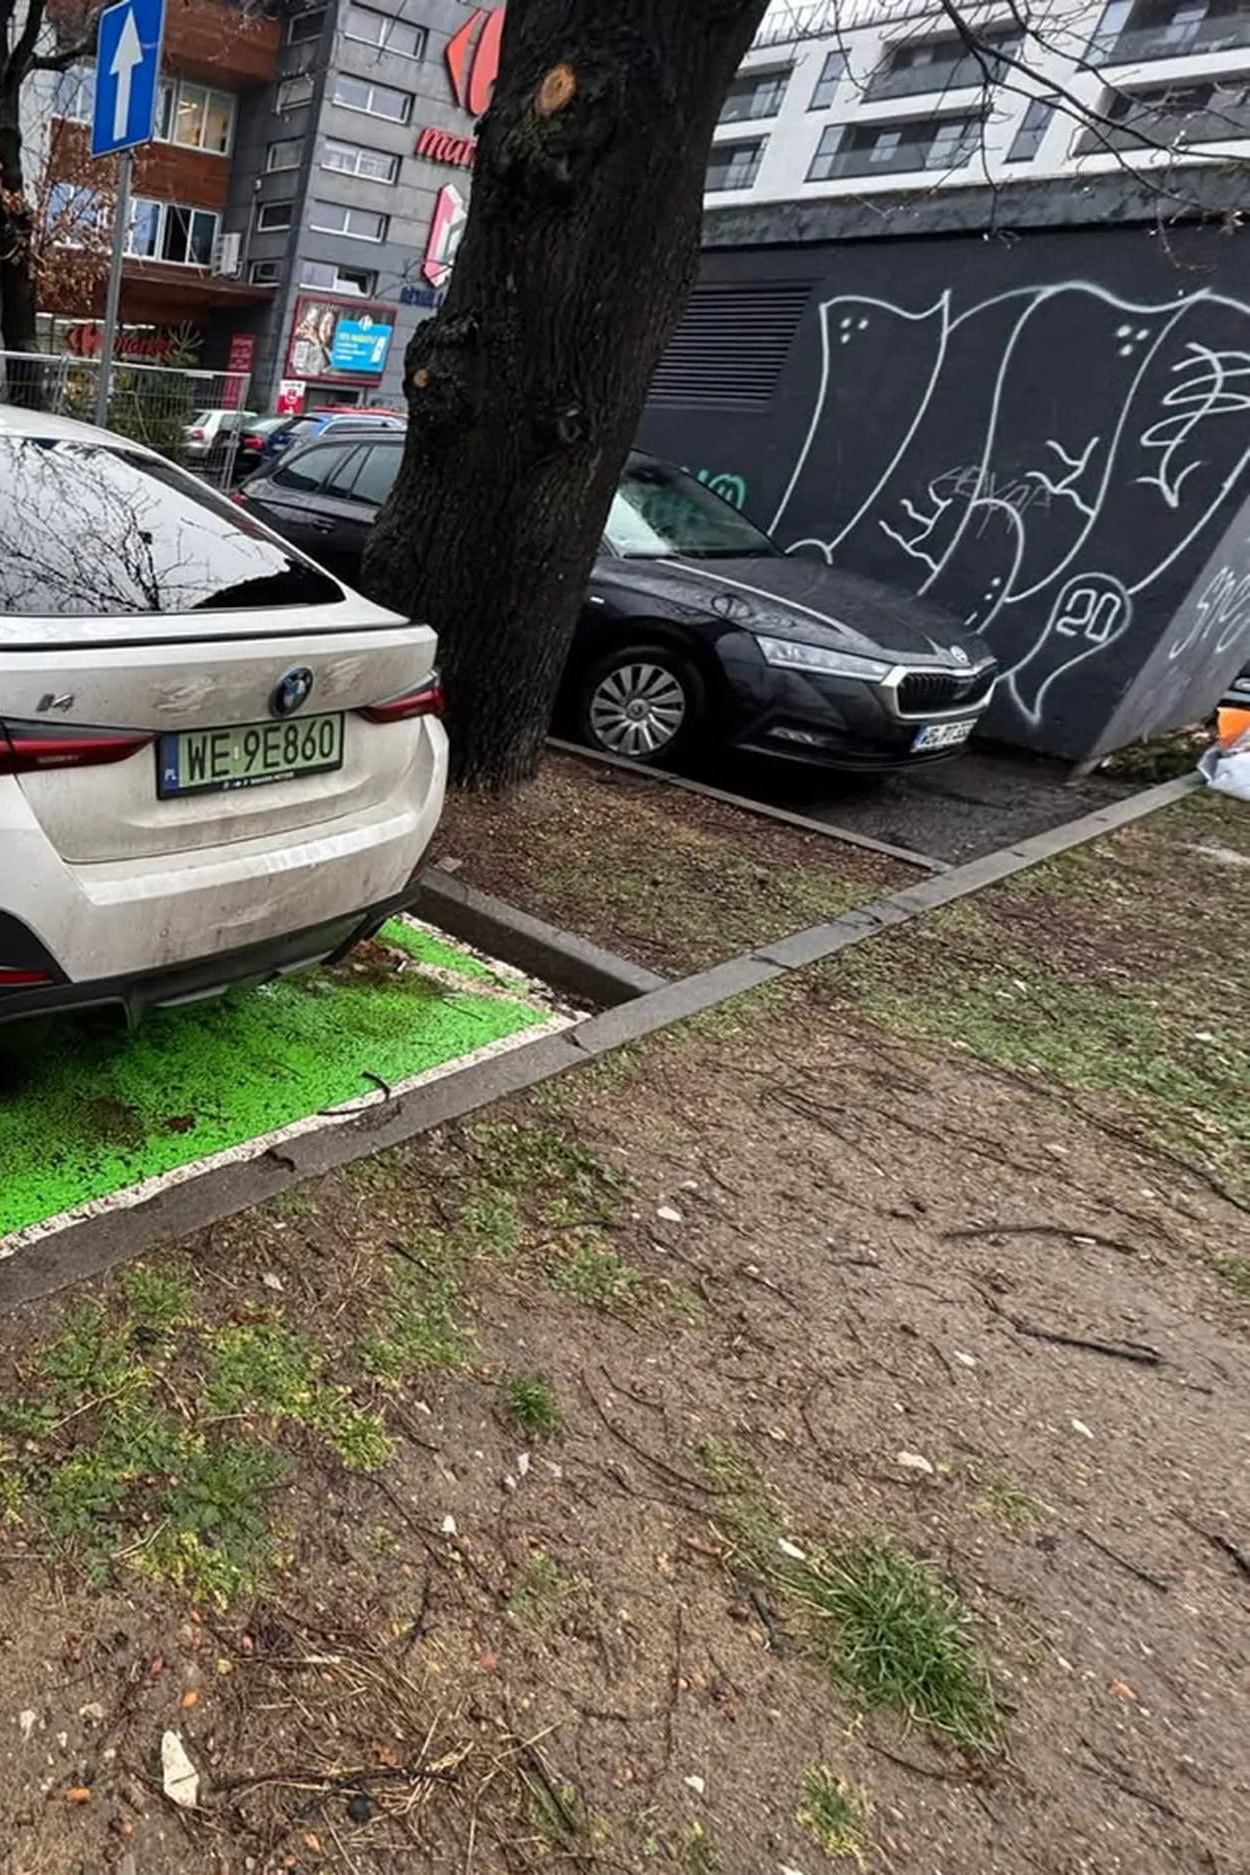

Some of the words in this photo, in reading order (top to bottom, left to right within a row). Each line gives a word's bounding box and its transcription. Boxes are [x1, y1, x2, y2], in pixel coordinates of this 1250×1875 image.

[1056, 588, 1121, 641] 20
[164, 767, 177, 781] PL
[187, 732, 231, 781] WE
[243, 719, 335, 773] 9E860
